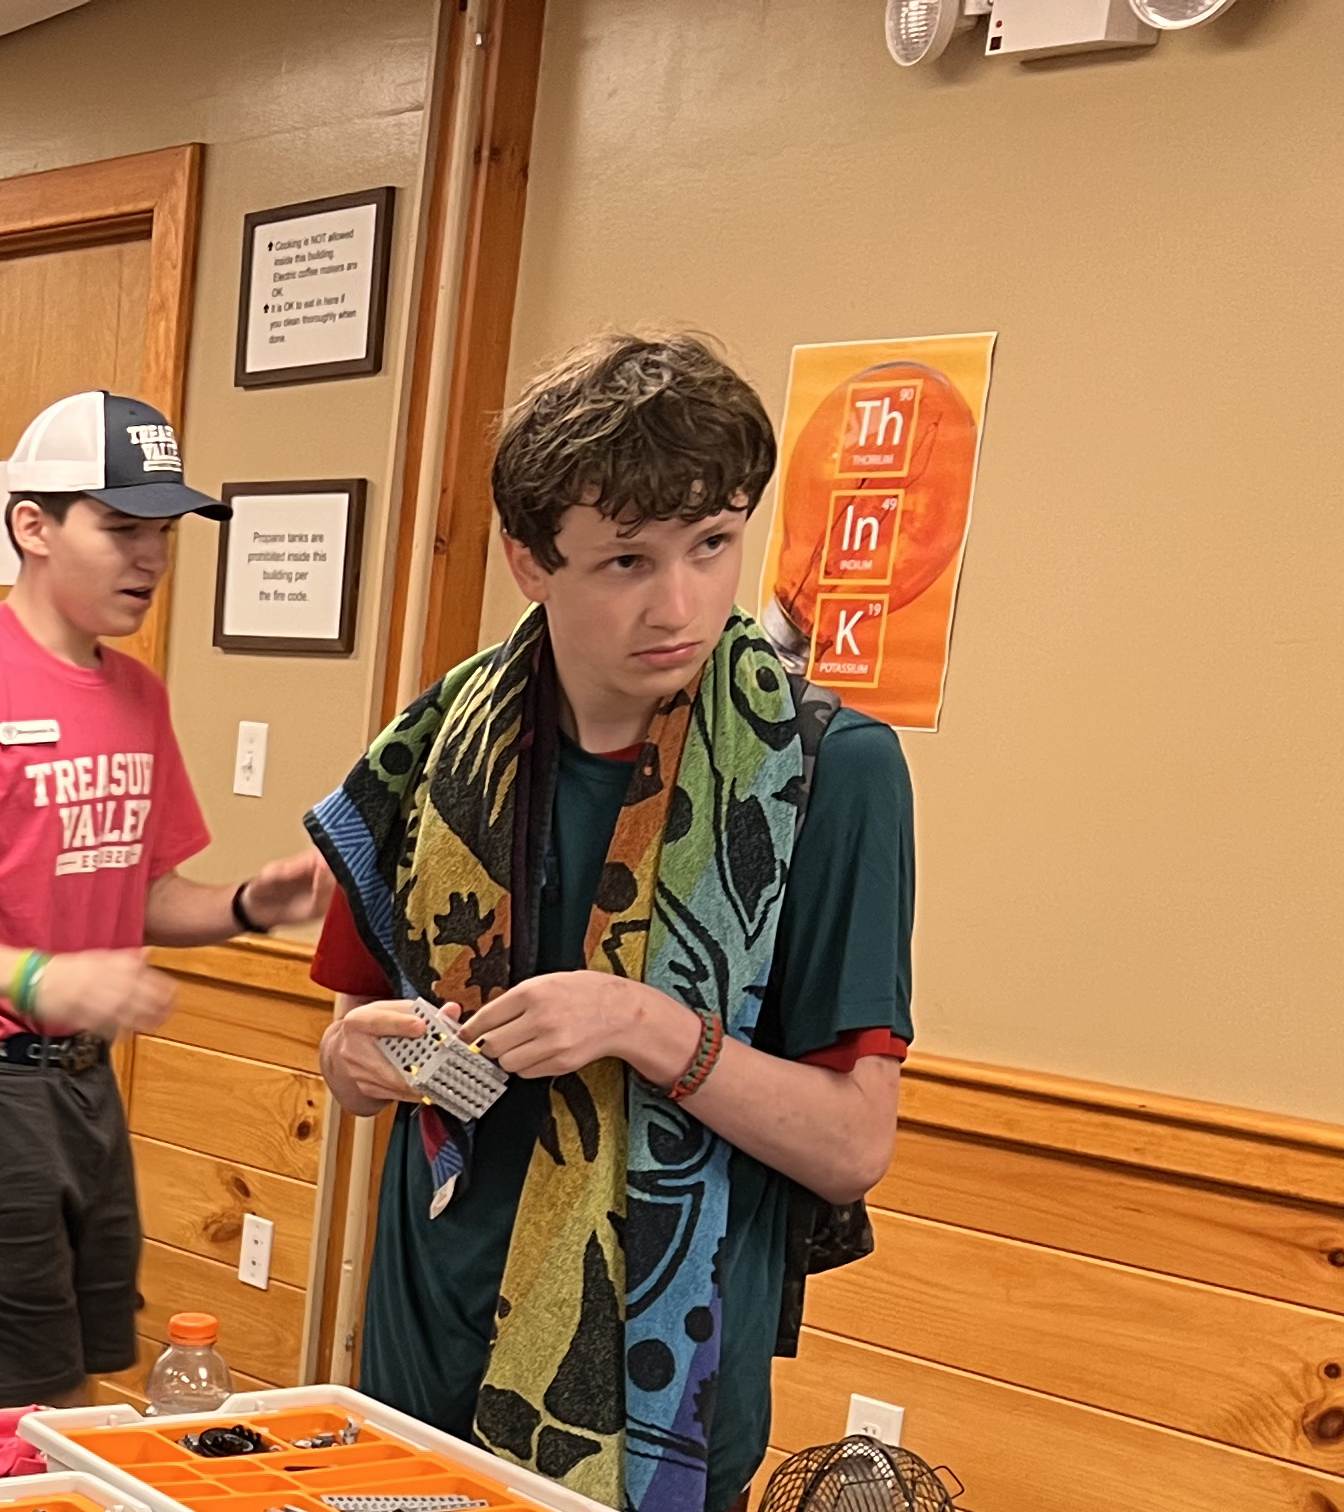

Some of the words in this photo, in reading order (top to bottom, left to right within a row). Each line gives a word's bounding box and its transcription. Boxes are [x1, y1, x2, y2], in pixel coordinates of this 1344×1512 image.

[275, 240, 302, 252] Cooking
[311, 233, 327, 245] NOT
[328, 229, 354, 243] allowed
[284, 301, 295, 311] OK
[898, 387, 915, 402] 90
[855, 397, 905, 448] Th
[852, 453, 895, 466] THORIUM
[881, 497, 898, 511] 49
[842, 504, 880, 552] In
[253, 531, 285, 544] Propane
[287, 533, 309, 543] tanks
[311, 533, 325, 543] are
[247, 552, 286, 564] prohibited
[287, 552, 310, 562] inside
[313, 551, 327, 562] this
[840, 559, 874, 571] INDIUM
[263, 570, 293, 583] building
[295, 571, 309, 582] per
[259, 590, 271, 601] the
[273, 590, 286, 601] fire
[868, 602, 883, 617] 19
[835, 609, 866, 657] K
[819, 661, 869, 675] POTASSIUM
